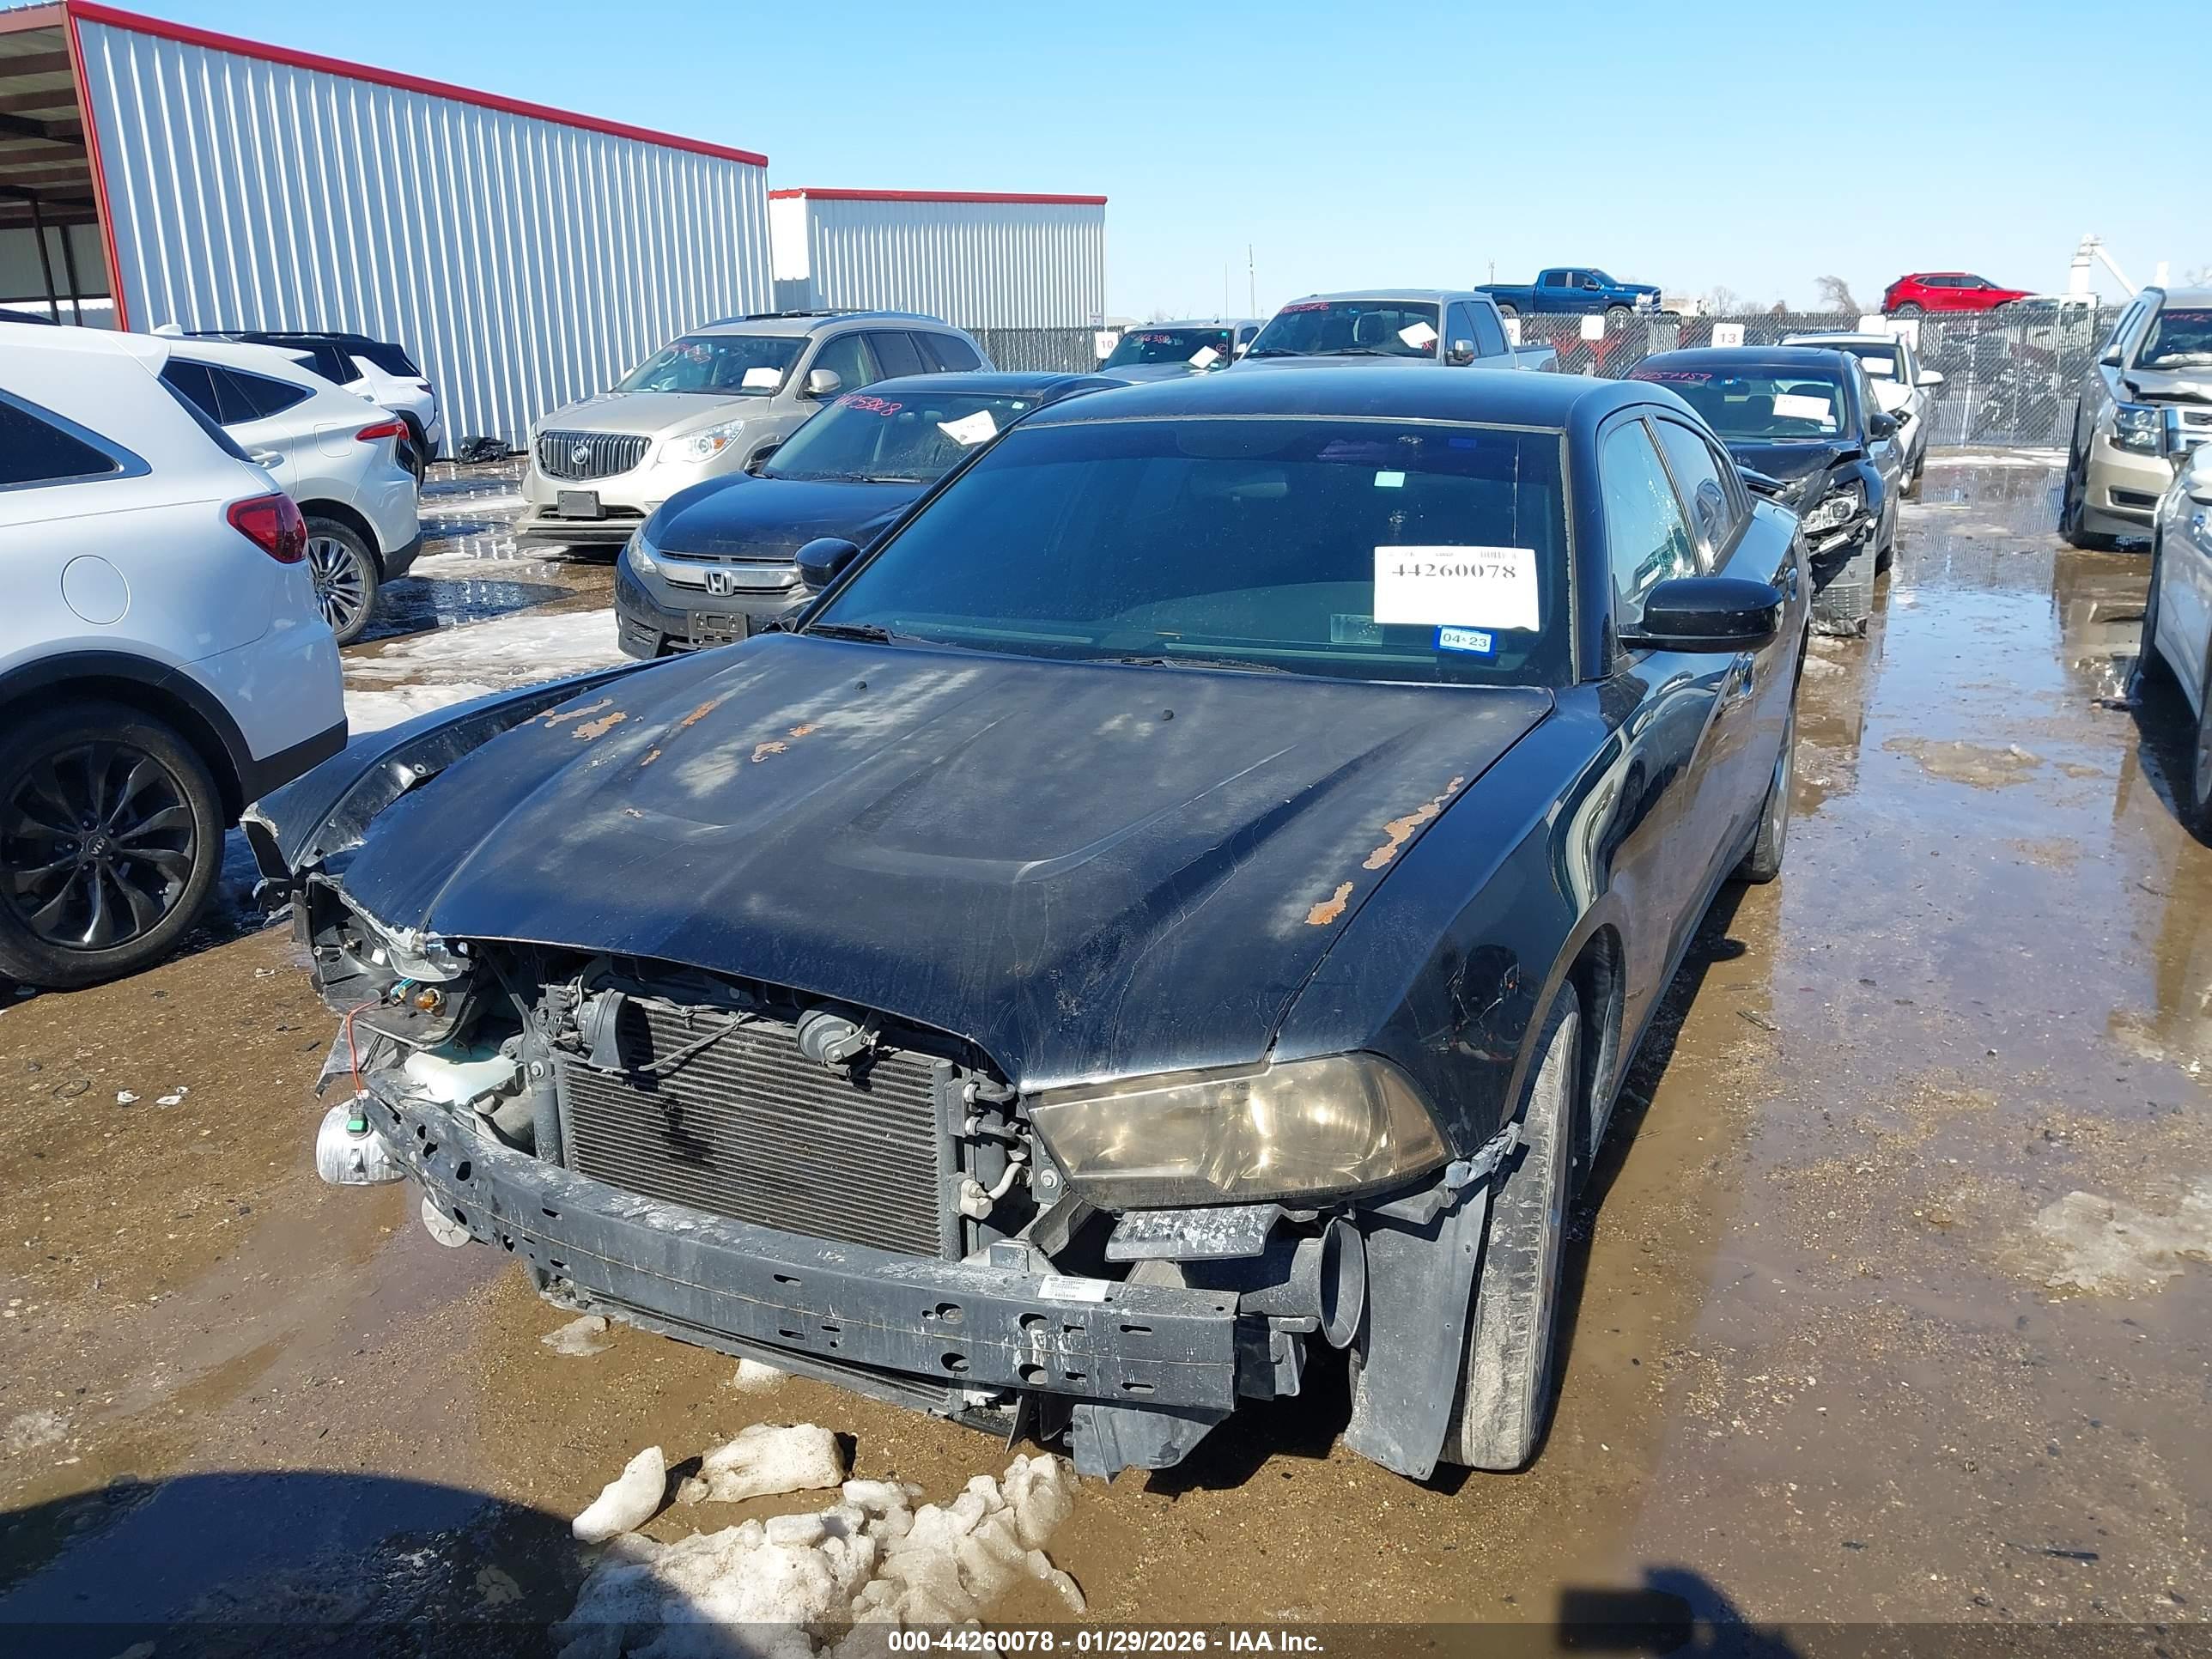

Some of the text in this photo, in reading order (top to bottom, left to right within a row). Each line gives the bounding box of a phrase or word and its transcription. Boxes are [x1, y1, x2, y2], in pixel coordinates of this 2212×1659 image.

[1719, 332, 1736, 343] 13
[1101, 340, 1114, 349] 10
[1391, 562, 1517, 579] 44260078
[1443, 633, 1487, 647] 04 23
